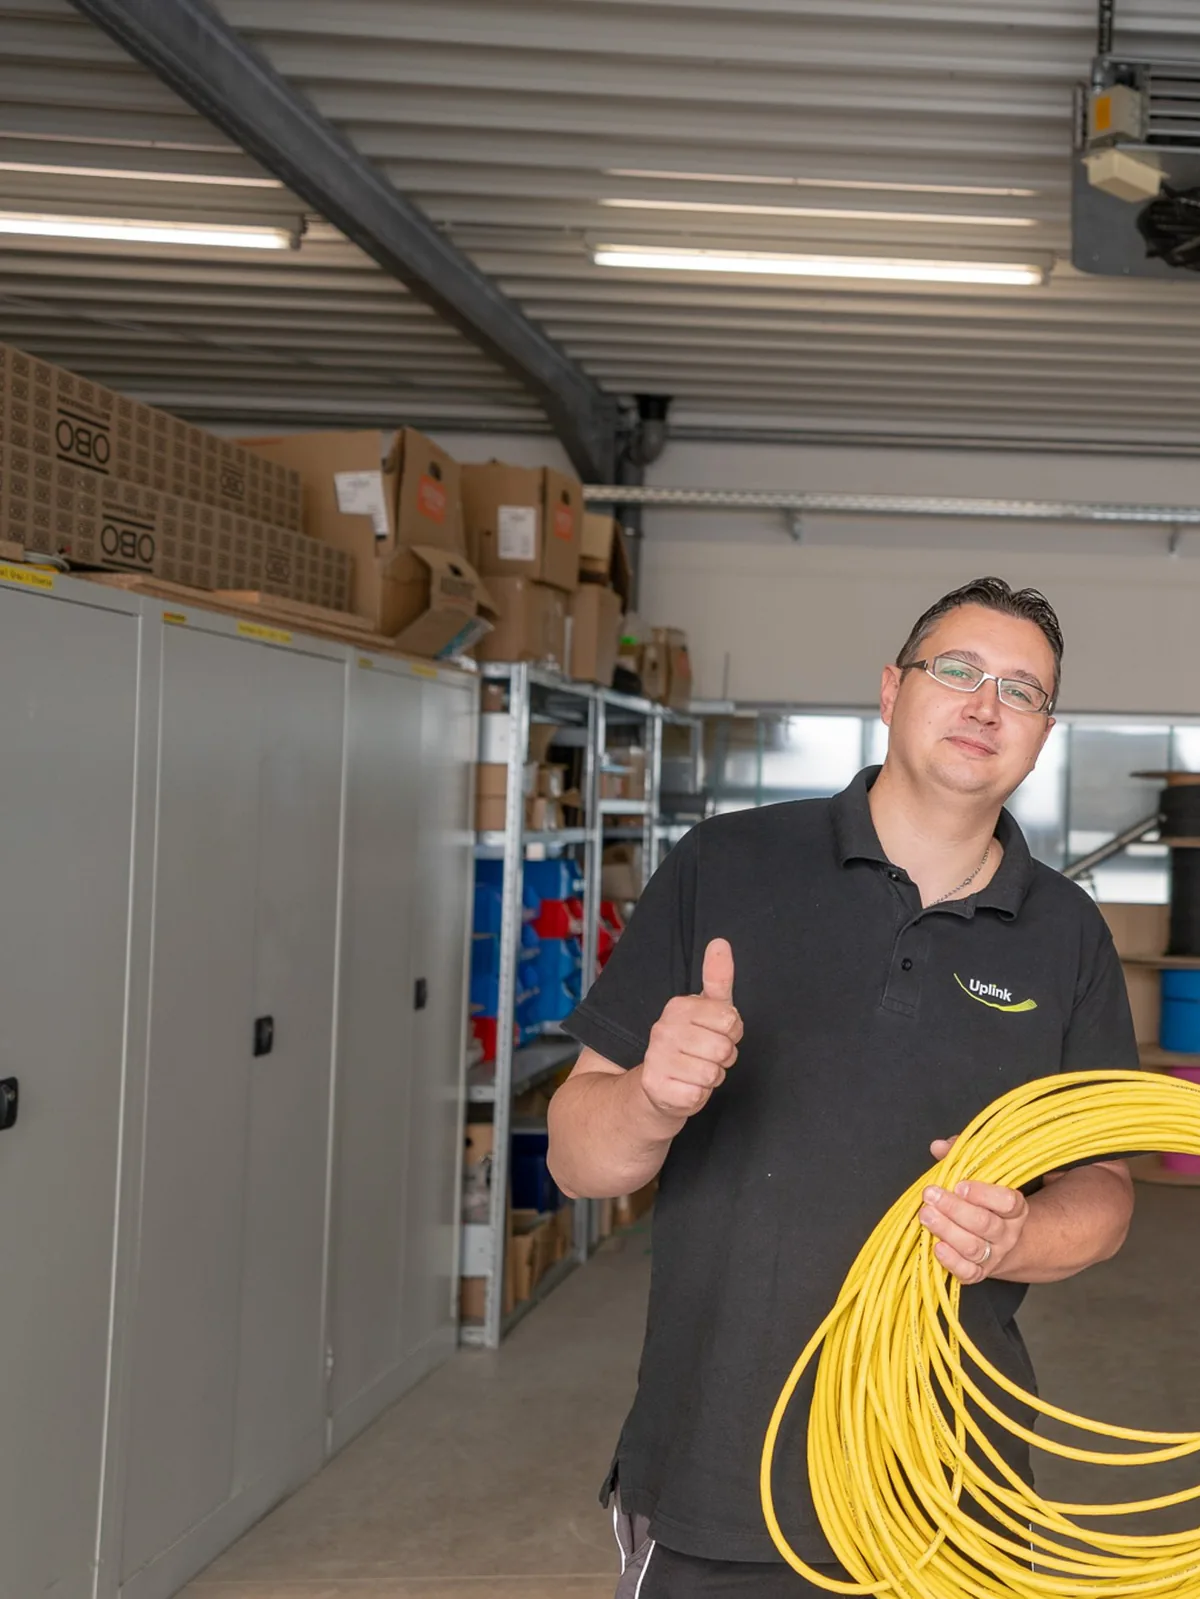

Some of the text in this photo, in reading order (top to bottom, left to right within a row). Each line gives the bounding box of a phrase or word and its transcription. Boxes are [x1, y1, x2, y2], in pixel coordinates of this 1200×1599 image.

[55, 419, 110, 465] OBO
[101, 524, 155, 564] OBO
[969, 978, 1013, 1002] Uplink
